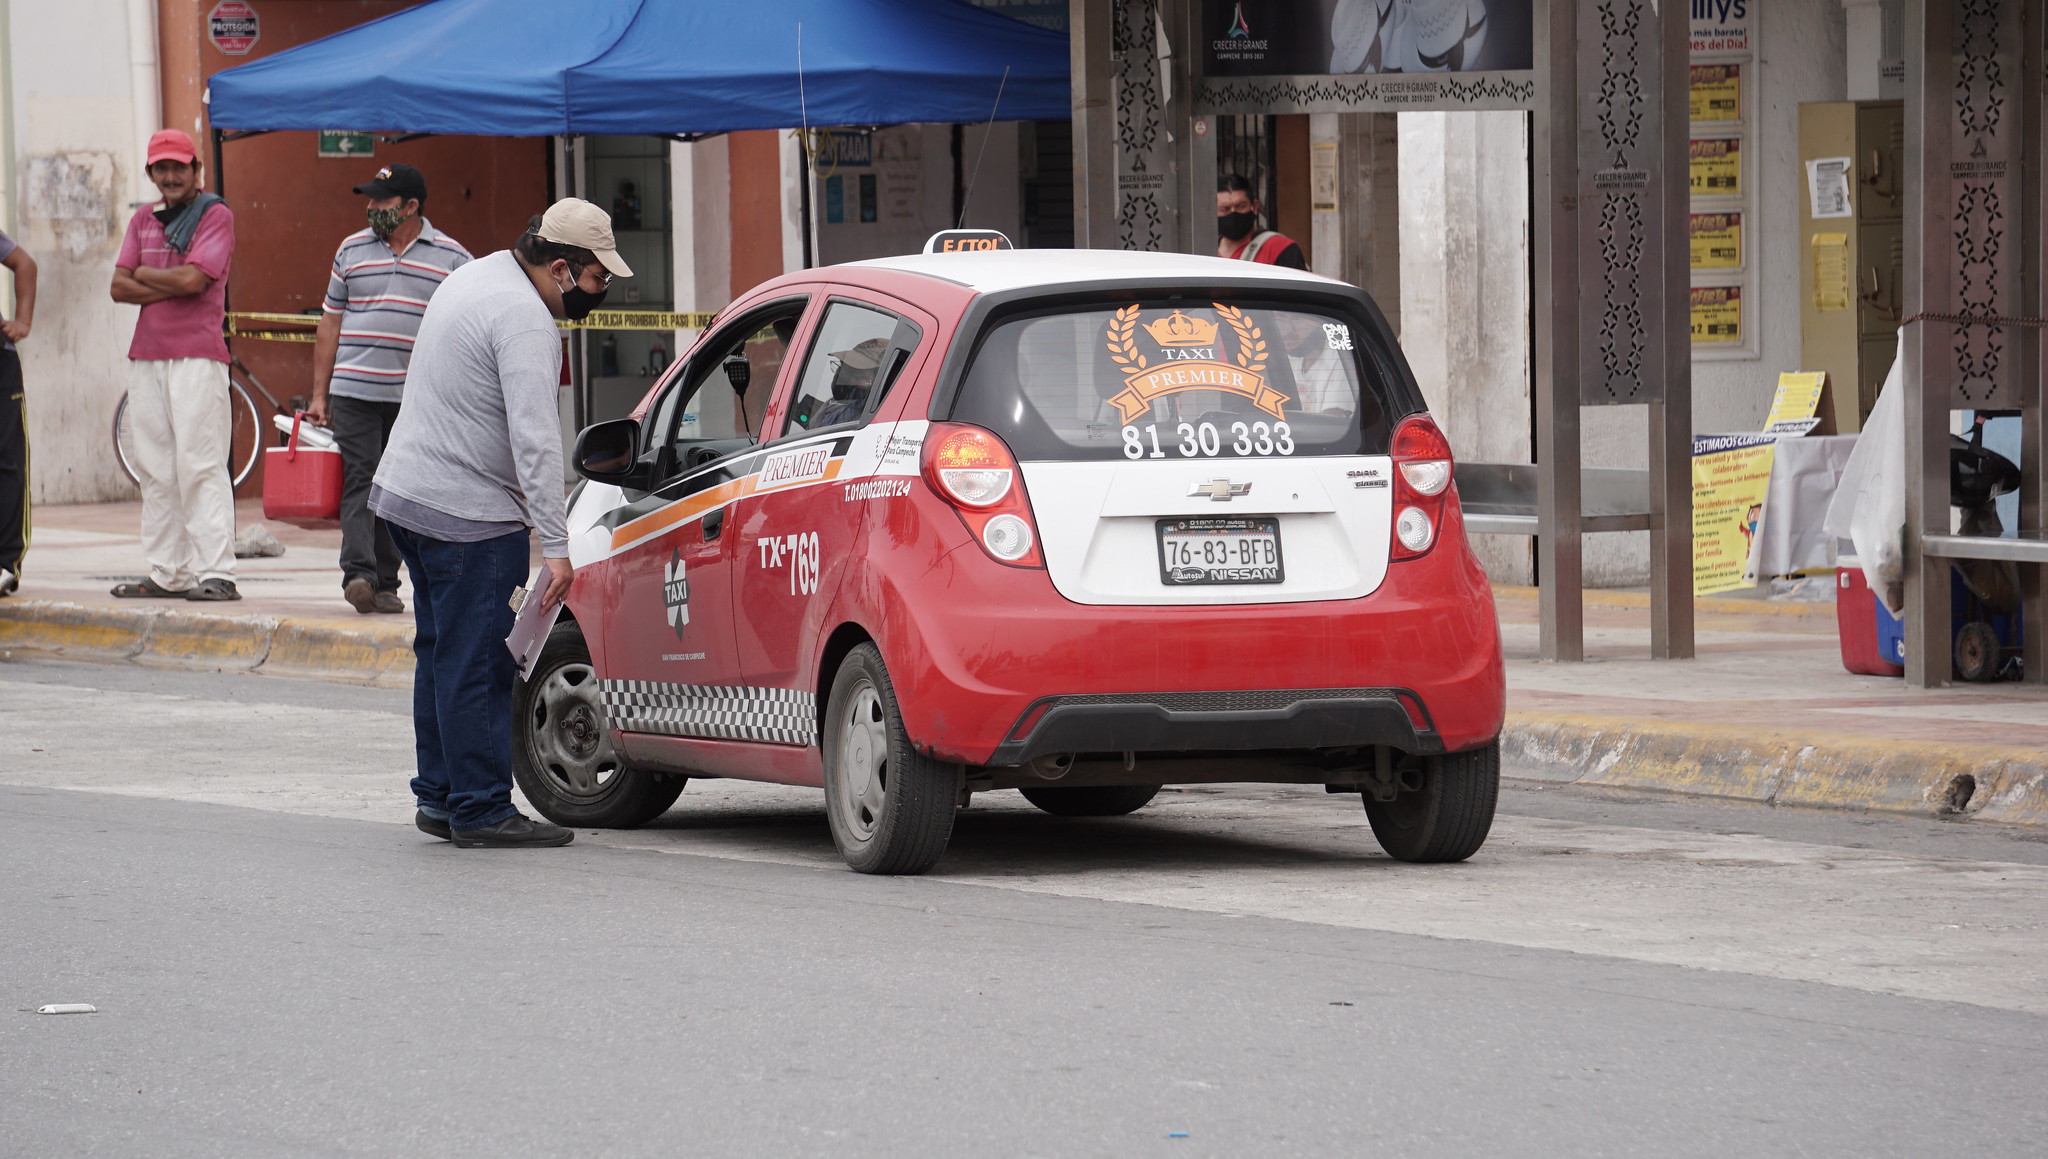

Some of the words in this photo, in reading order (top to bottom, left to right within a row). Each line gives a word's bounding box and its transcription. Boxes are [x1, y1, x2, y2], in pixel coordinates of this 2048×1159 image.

[1694, 28, 1712, 37] más
[1213, 40, 1237, 50] CRECER
[1243, 40, 1268, 50] GRANDE
[1709, 39, 1724, 49] del
[1381, 83, 1405, 93] CRECER
[1411, 82, 1437, 92] GRANDE
[1384, 95, 1408, 103] CAMPECHE
[589, 314, 598, 326] DE
[599, 314, 622, 327] POLICIA
[625, 314, 660, 327] PROHIBIDO
[661, 315, 669, 327] EL
[671, 315, 689, 328] PASO
[1161, 348, 1215, 360] TAXI
[1149, 369, 1244, 389] PREMIER
[1121, 424, 1166, 460] 81
[1176, 422, 1220, 457] 30
[1231, 421, 1295, 456] 333
[1694, 436, 1736, 454] ESTIMADOS
[763, 450, 827, 483] PREMIER
[845, 480, 912, 502] T.018002202124
[1699, 539, 1720, 549] persona
[1167, 539, 1275, 565] 76-83-BFB
[1695, 552, 1705, 561] por
[758, 531, 820, 596] TX-769
[1210, 568, 1277, 581] NISSAN
[665, 581, 687, 604] TAXI
